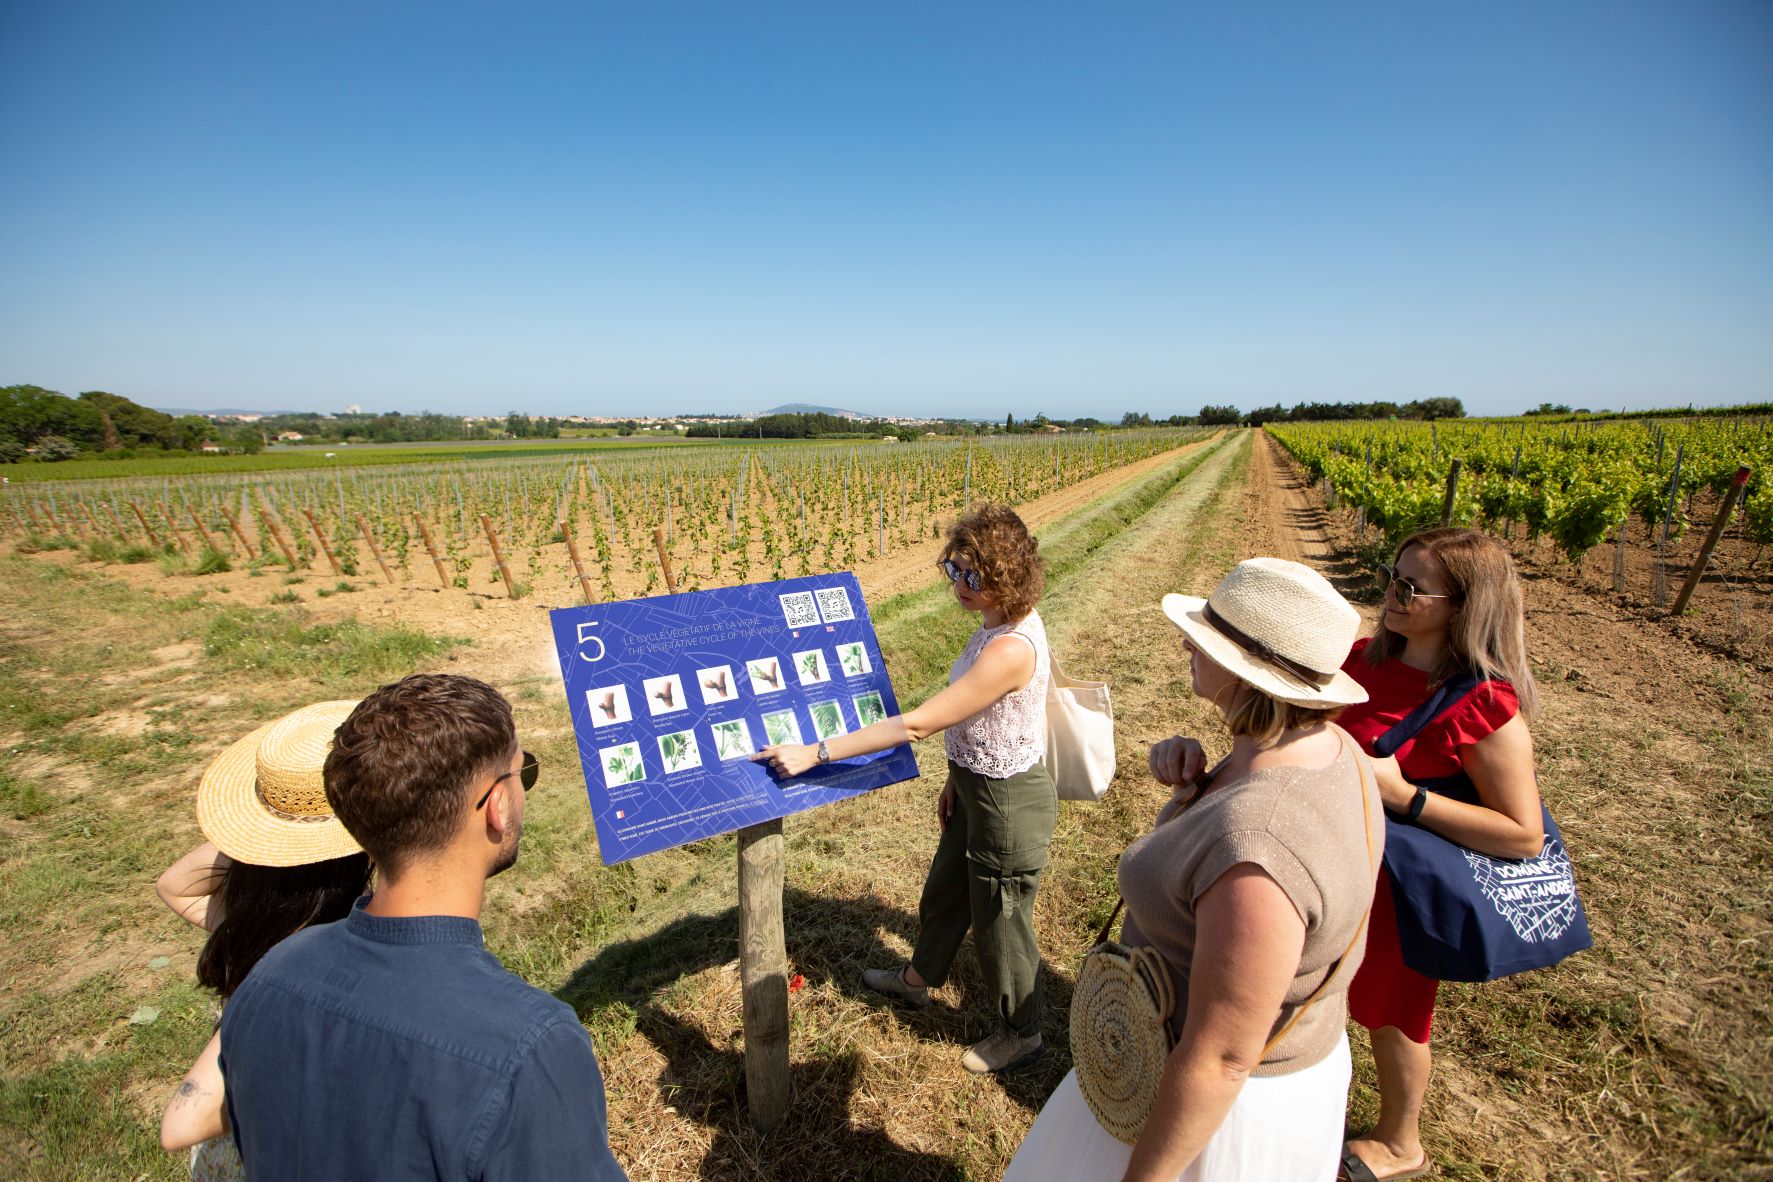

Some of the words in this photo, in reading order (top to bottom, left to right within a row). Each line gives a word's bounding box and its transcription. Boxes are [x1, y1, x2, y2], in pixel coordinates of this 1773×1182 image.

[576, 621, 606, 662] 5
[623, 636, 635, 646] LE
[637, 631, 665, 644] CYCLE
[713, 622, 725, 632] DE
[737, 617, 761, 627] VIGNE
[627, 645, 645, 656] THE
[647, 637, 698, 653] VEGETATIVE
[699, 633, 727, 645] CYCLE
[727, 631, 738, 640] OF
[740, 629, 756, 638] THE
[757, 624, 780, 635] VINES
